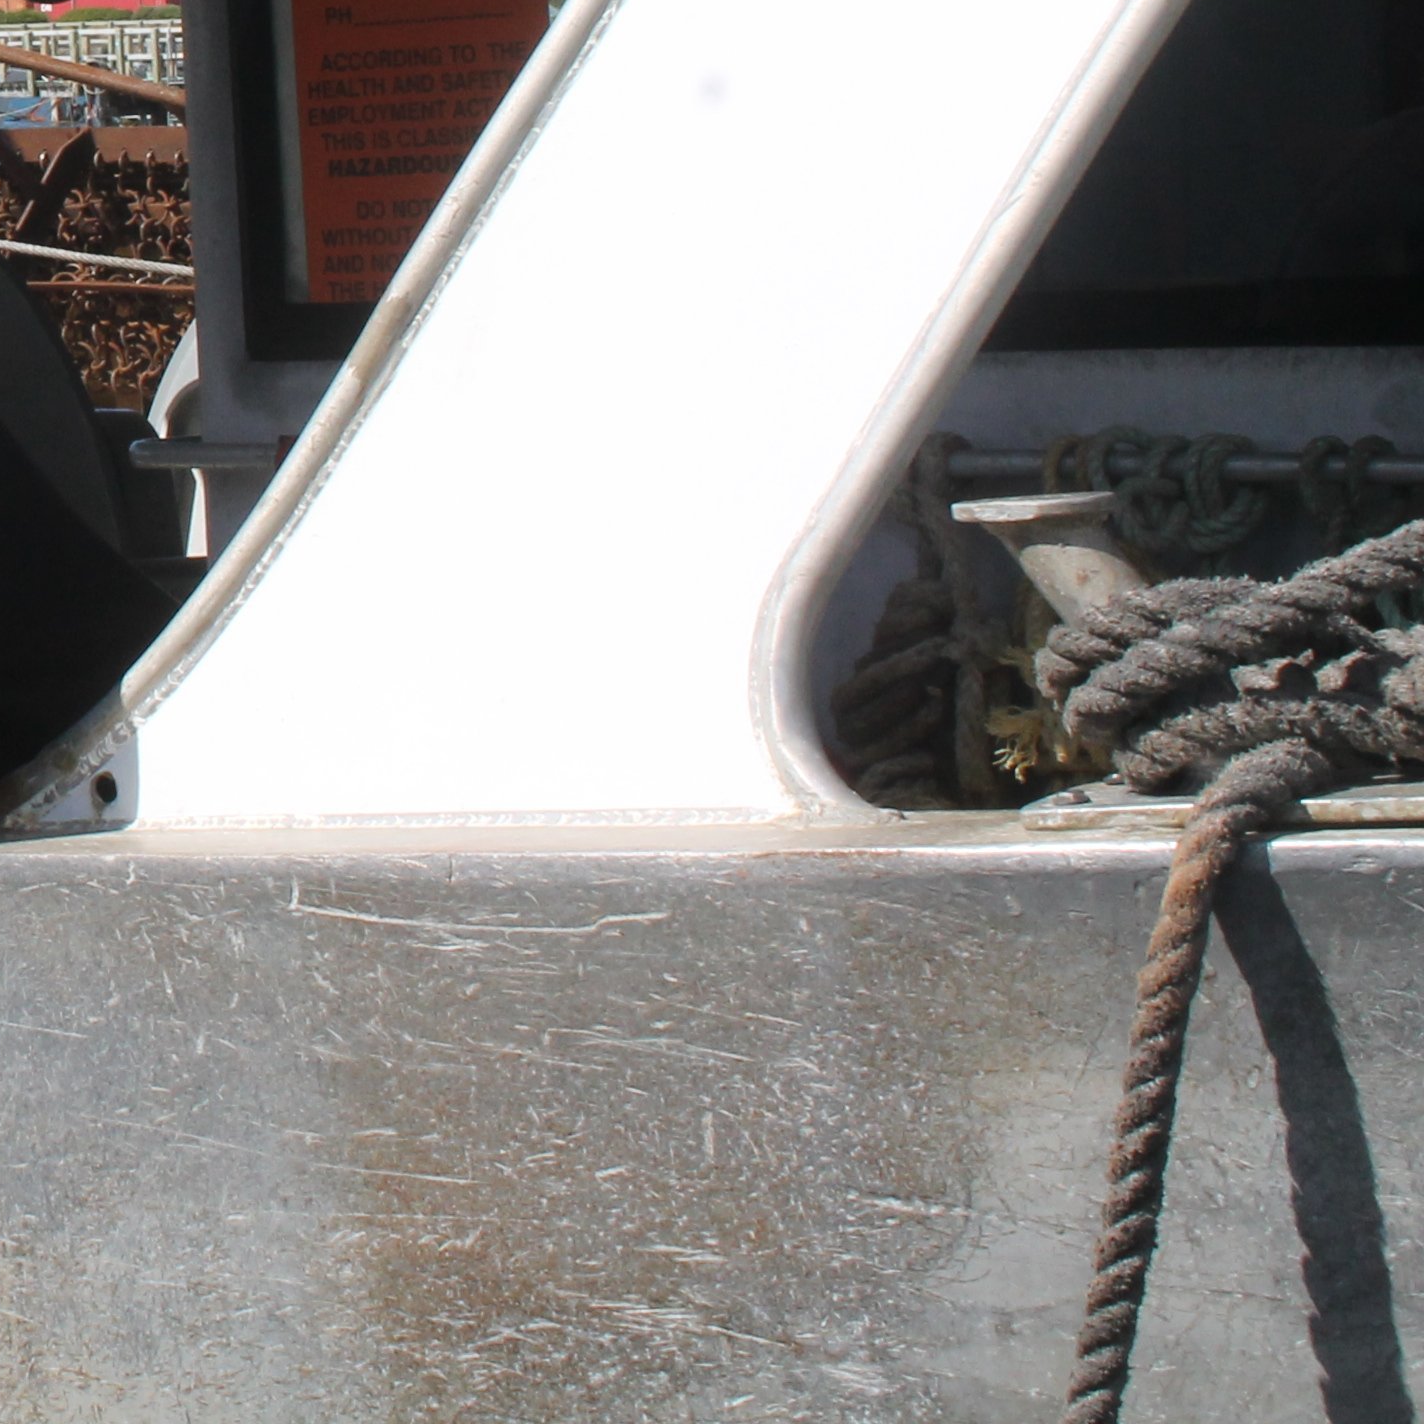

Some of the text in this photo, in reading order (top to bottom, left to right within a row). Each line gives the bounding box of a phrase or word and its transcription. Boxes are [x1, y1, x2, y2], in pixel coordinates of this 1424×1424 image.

[325, 6, 353, 25] PH
[321, 40, 526, 70] ACCORDING TO THE
[308, 78, 385, 99] HEALTH
[393, 74, 433, 94] AND
[308, 97, 493, 126] EMPLOYMENT ACT
[321, 130, 365, 152] THIS
[373, 129, 390, 148] IS
[357, 199, 435, 219] DO NOT
[322, 226, 417, 248] WITHOUT
[324, 255, 364, 275] AND
[328, 281, 365, 302] THE
